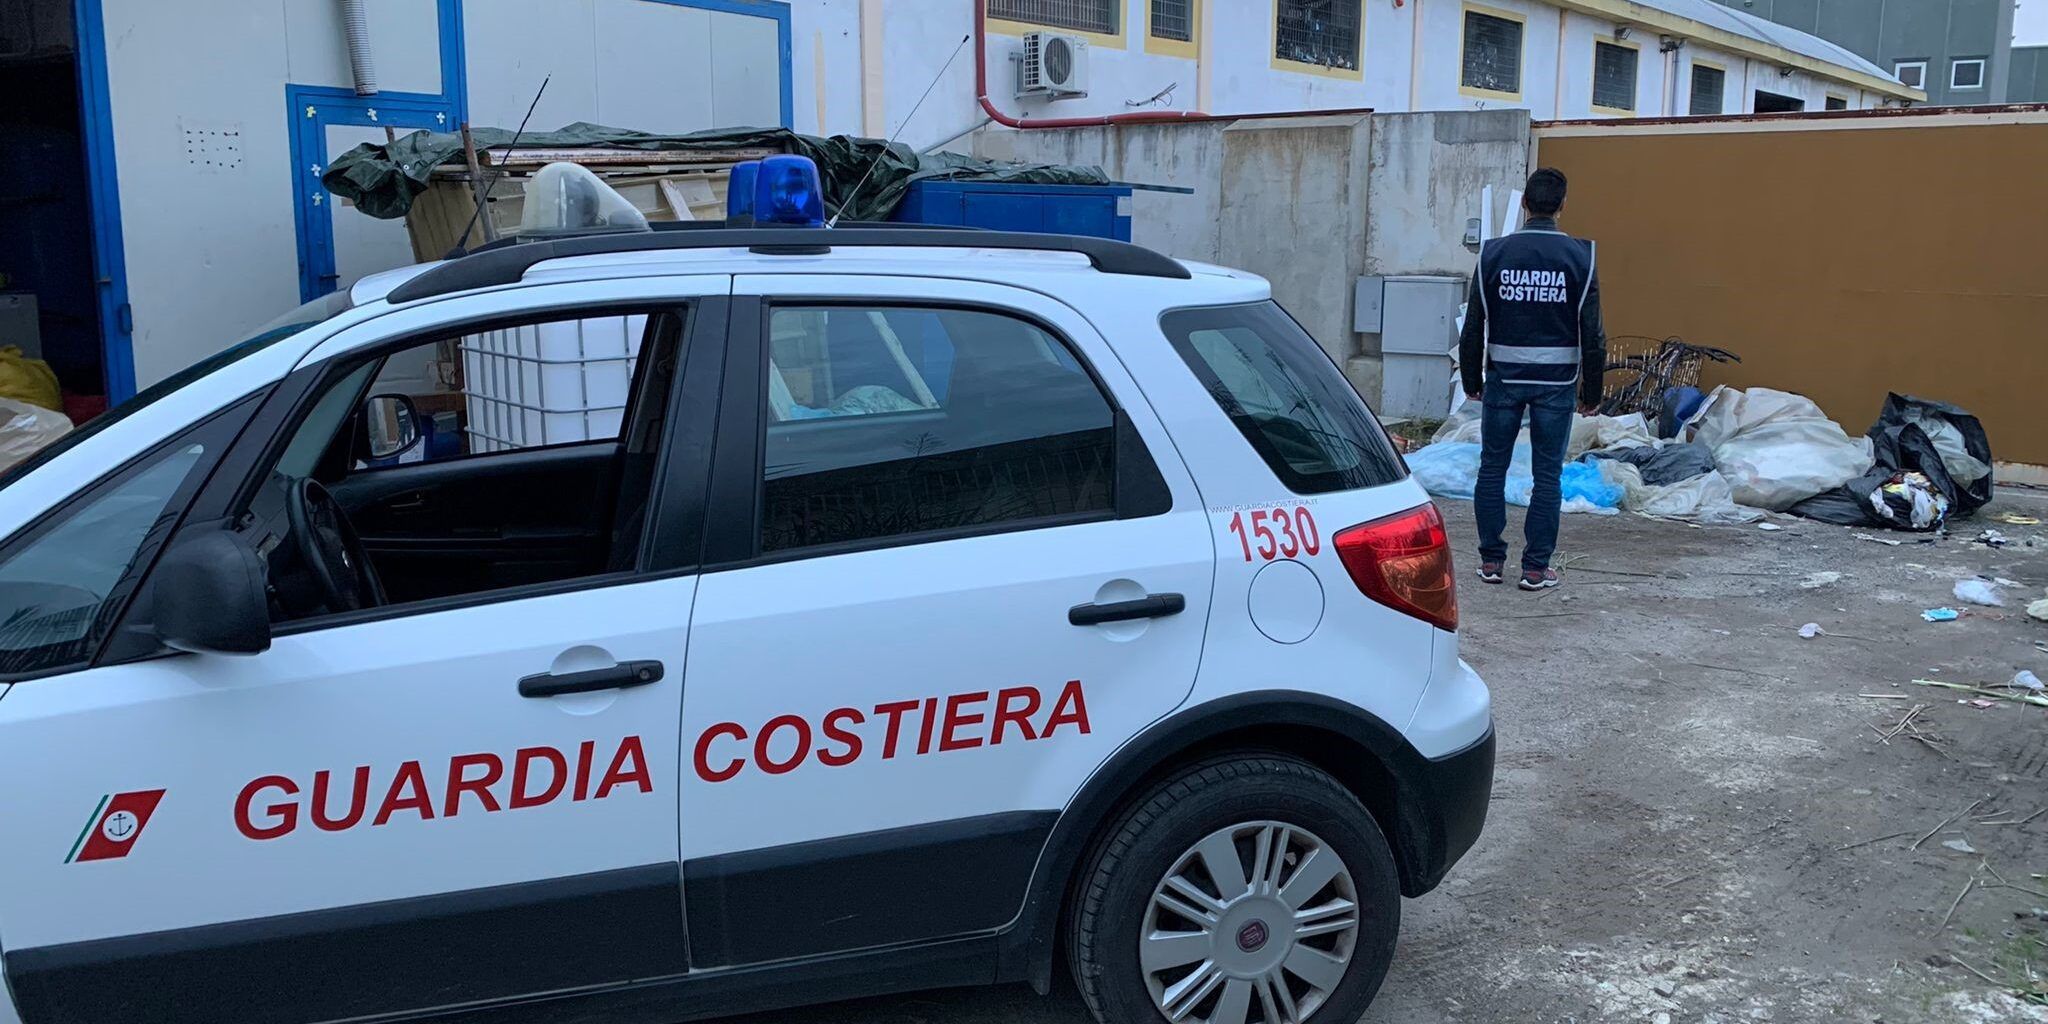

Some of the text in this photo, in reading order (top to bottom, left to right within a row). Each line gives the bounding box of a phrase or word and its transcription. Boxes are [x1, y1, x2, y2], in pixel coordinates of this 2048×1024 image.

[1498, 285, 1568, 303] COSTIERA
[1500, 269, 1567, 287] GUARDIA
[1229, 506, 1320, 562] 1530
[235, 681, 1090, 840] GUARDIA COSTIERA
